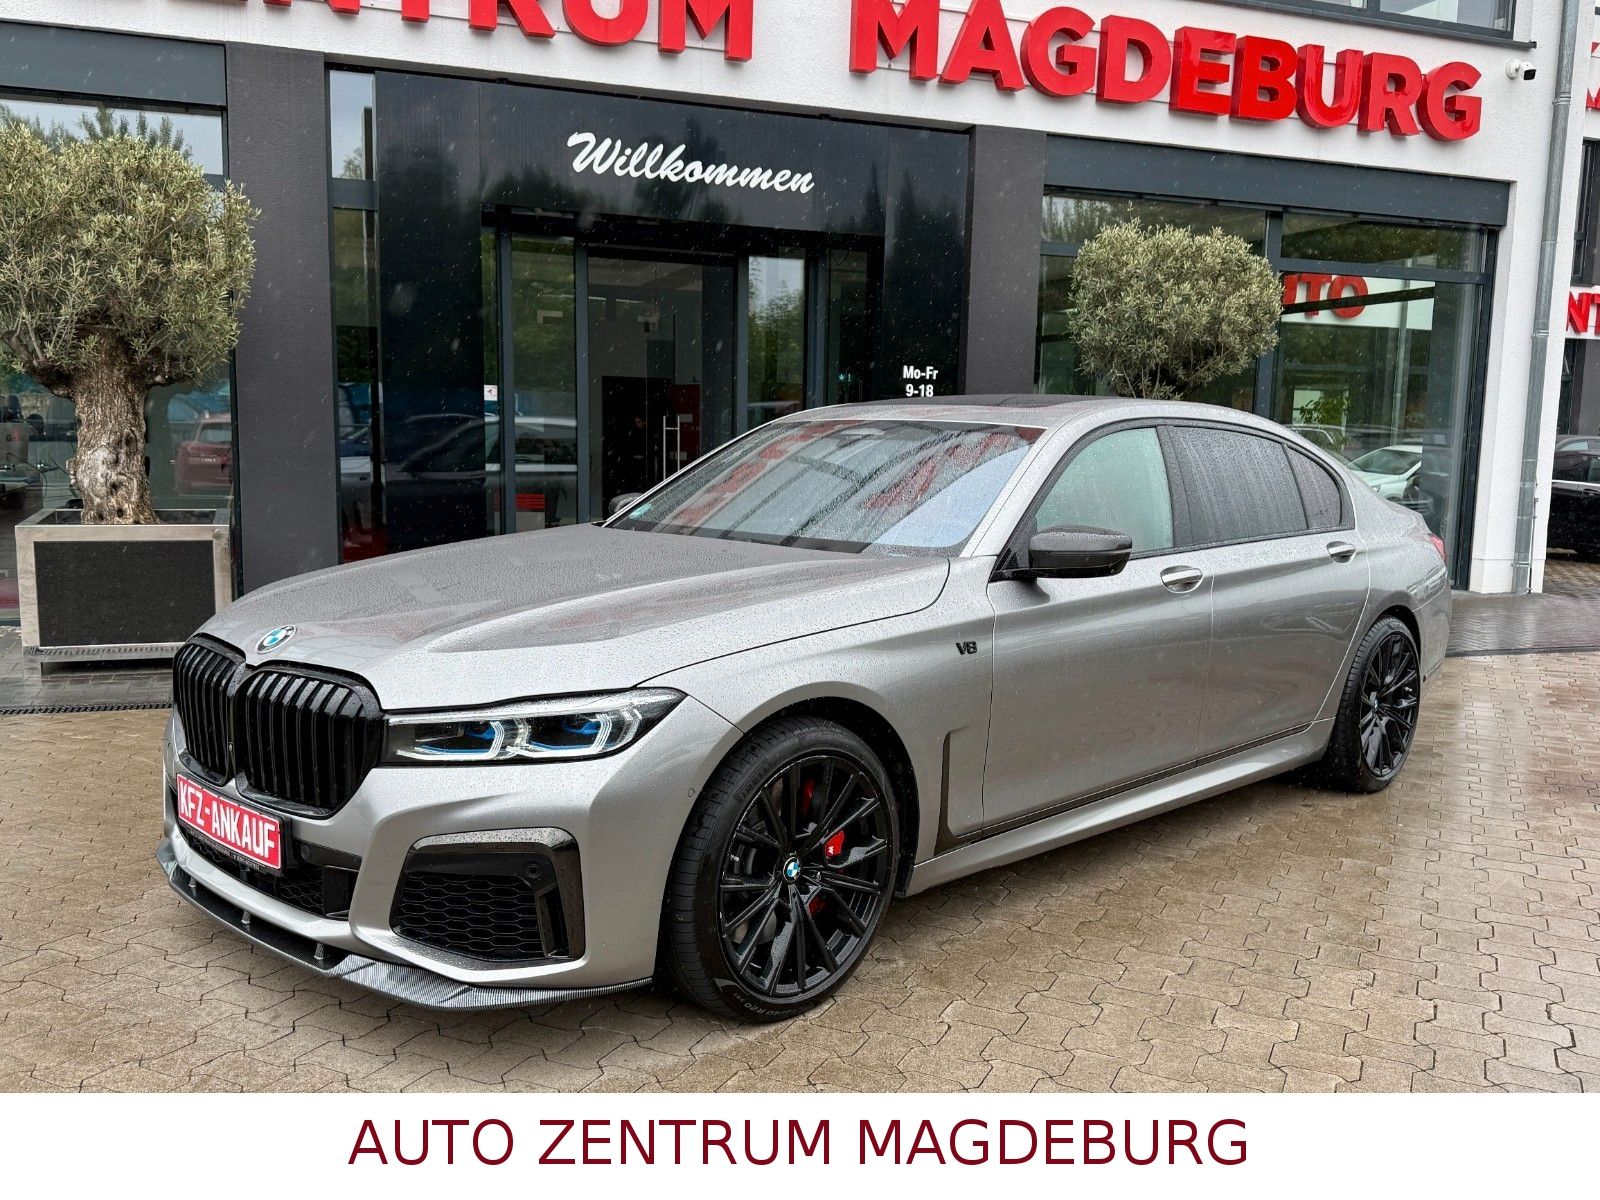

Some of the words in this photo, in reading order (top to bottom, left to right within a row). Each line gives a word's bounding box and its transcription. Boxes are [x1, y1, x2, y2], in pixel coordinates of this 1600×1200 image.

[849, 0, 1482, 142] MAGDEBURG
[567, 132, 815, 194] Willkommen
[902, 365, 939, 380] Mo-Fr
[905, 383, 934, 398] 9-18
[179, 780, 277, 859] KFZ-ANKAUF
